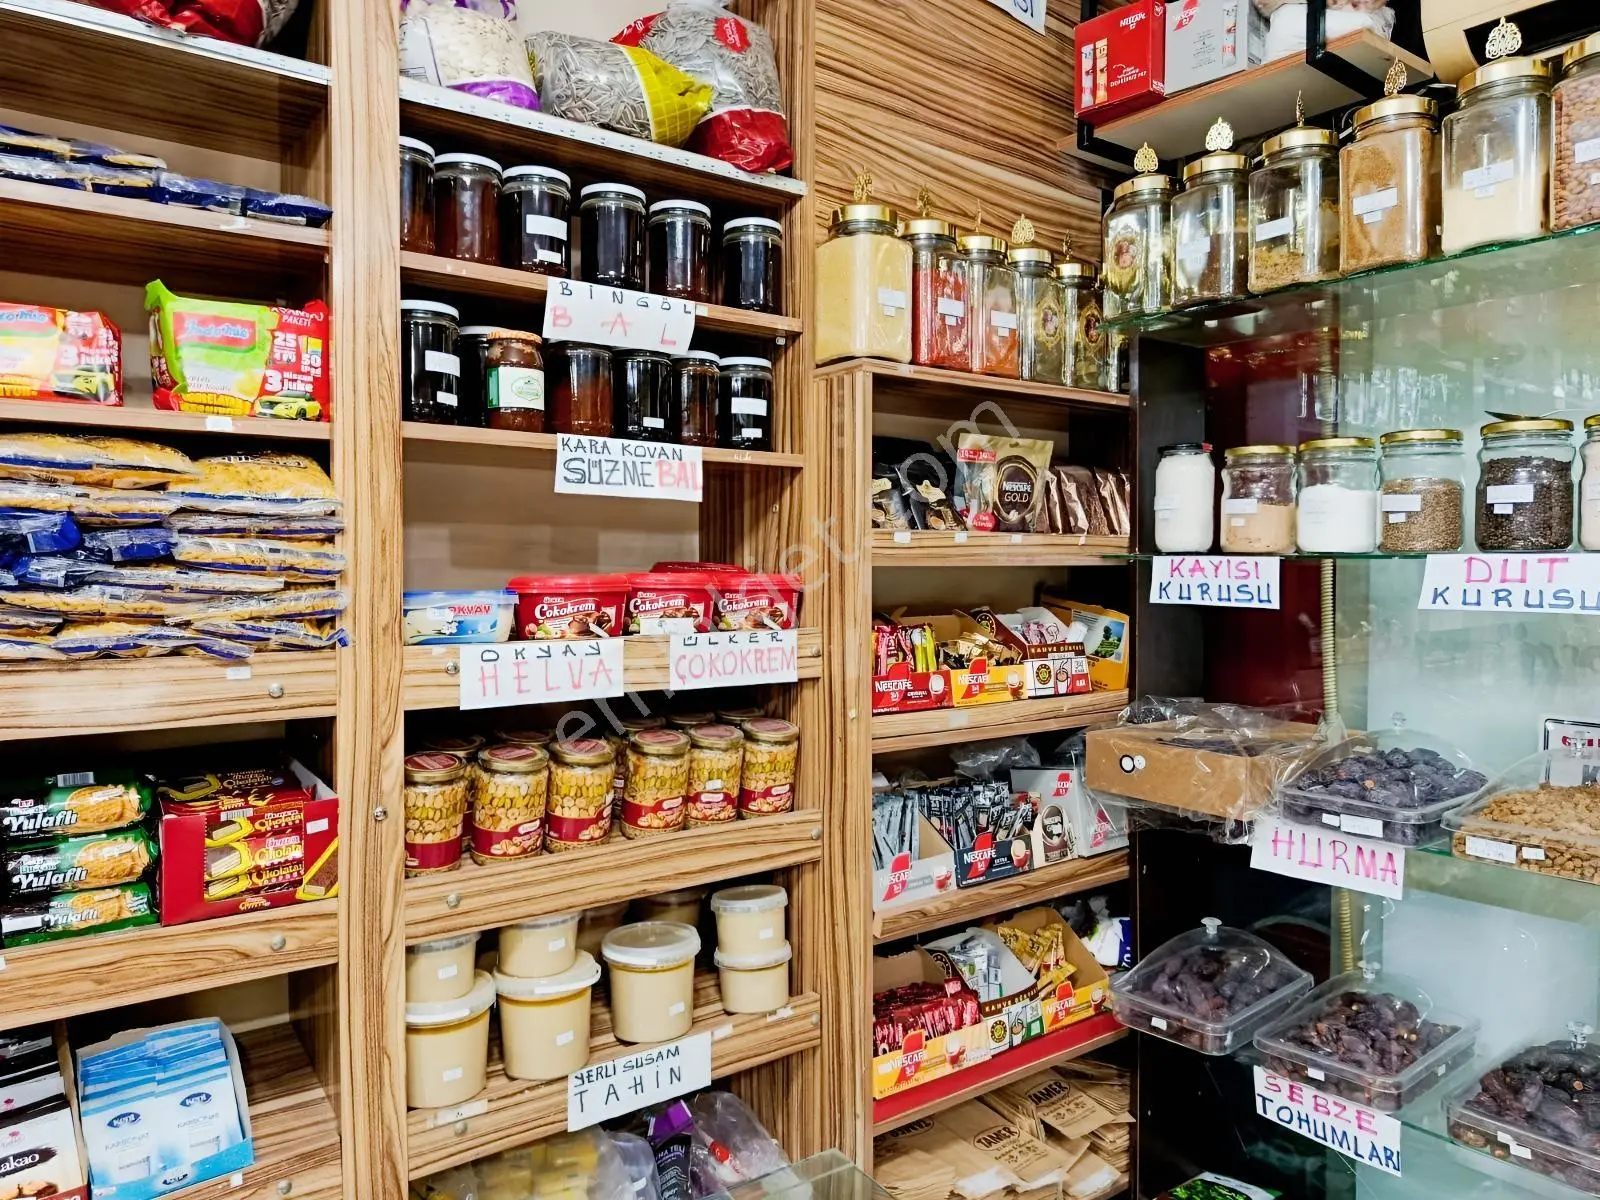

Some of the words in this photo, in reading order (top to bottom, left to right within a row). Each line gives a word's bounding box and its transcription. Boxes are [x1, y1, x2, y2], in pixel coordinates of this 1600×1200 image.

[559, 281, 692, 314] BİNGÖL
[551, 305, 677, 346] BAL
[265, 370, 283, 392] 3
[561, 437, 611, 455] KARA
[621, 442, 683, 461] KOVAN
[563, 457, 655, 488] SÜZME
[656, 459, 703, 491] BAL
[1004, 492, 1029, 503] GOLD
[1170, 558, 1260, 580] KAYISI
[1464, 556, 1569, 584] DUT
[1159, 581, 1272, 604] KURUSU
[1432, 586, 1600, 611] KURUSU
[683, 631, 783, 647] ÜLKER
[478, 658, 613, 697] HELVA
[675, 646, 797, 685] ÇOKOKREM
[1272, 827, 1398, 886] HURMA
[574, 1059, 617, 1087] YERLİ
[622, 1045, 680, 1073] SUSAM
[574, 1065, 681, 1113] TAHİN
[1264, 1073, 1378, 1136] SEBZE
[976, 1126, 1018, 1149] TAMER
[0, 1153, 40, 1174] akao
